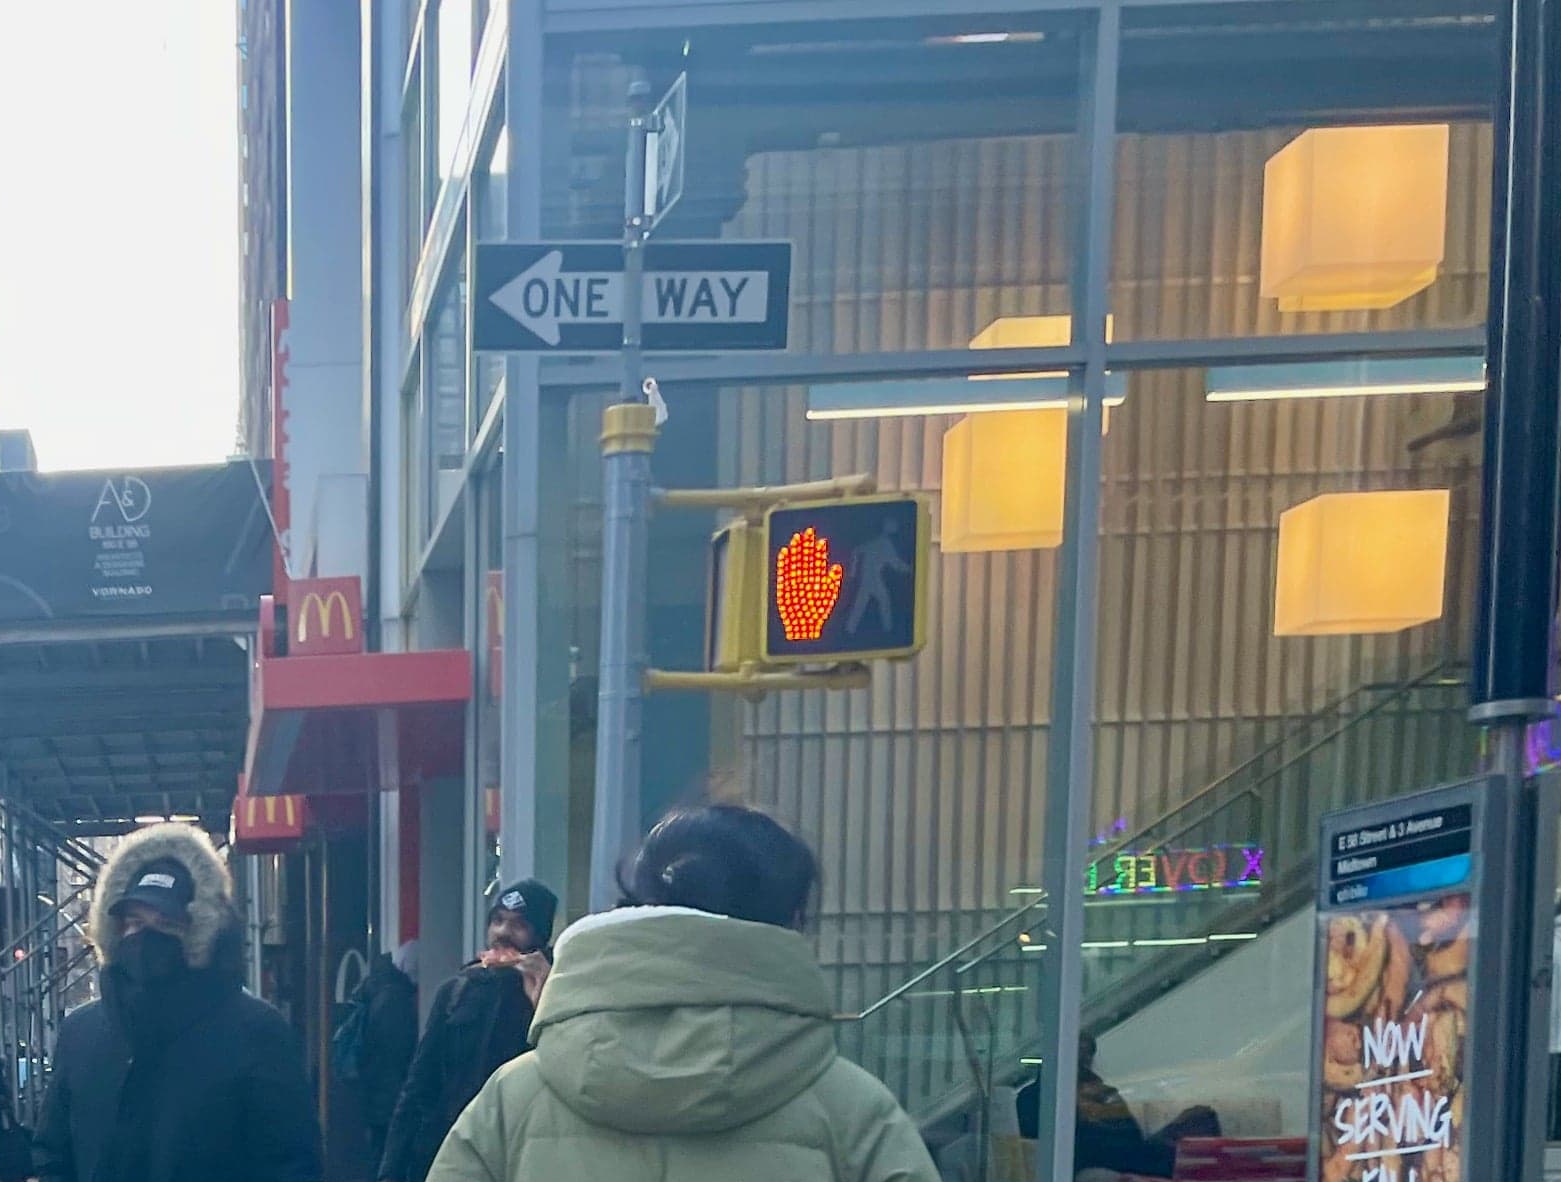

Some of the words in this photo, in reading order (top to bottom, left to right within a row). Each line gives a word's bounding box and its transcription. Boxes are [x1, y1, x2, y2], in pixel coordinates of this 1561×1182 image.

[522, 277, 609, 319] ONE
[654, 277, 750, 318] WAY
[90, 475, 152, 523] A&D
[88, 525, 151, 540] BUILDING
[91, 585, 153, 597] VORNADO
[1363, 1013, 1429, 1069] NOW
[1334, 1090, 1452, 1149] SERVING
